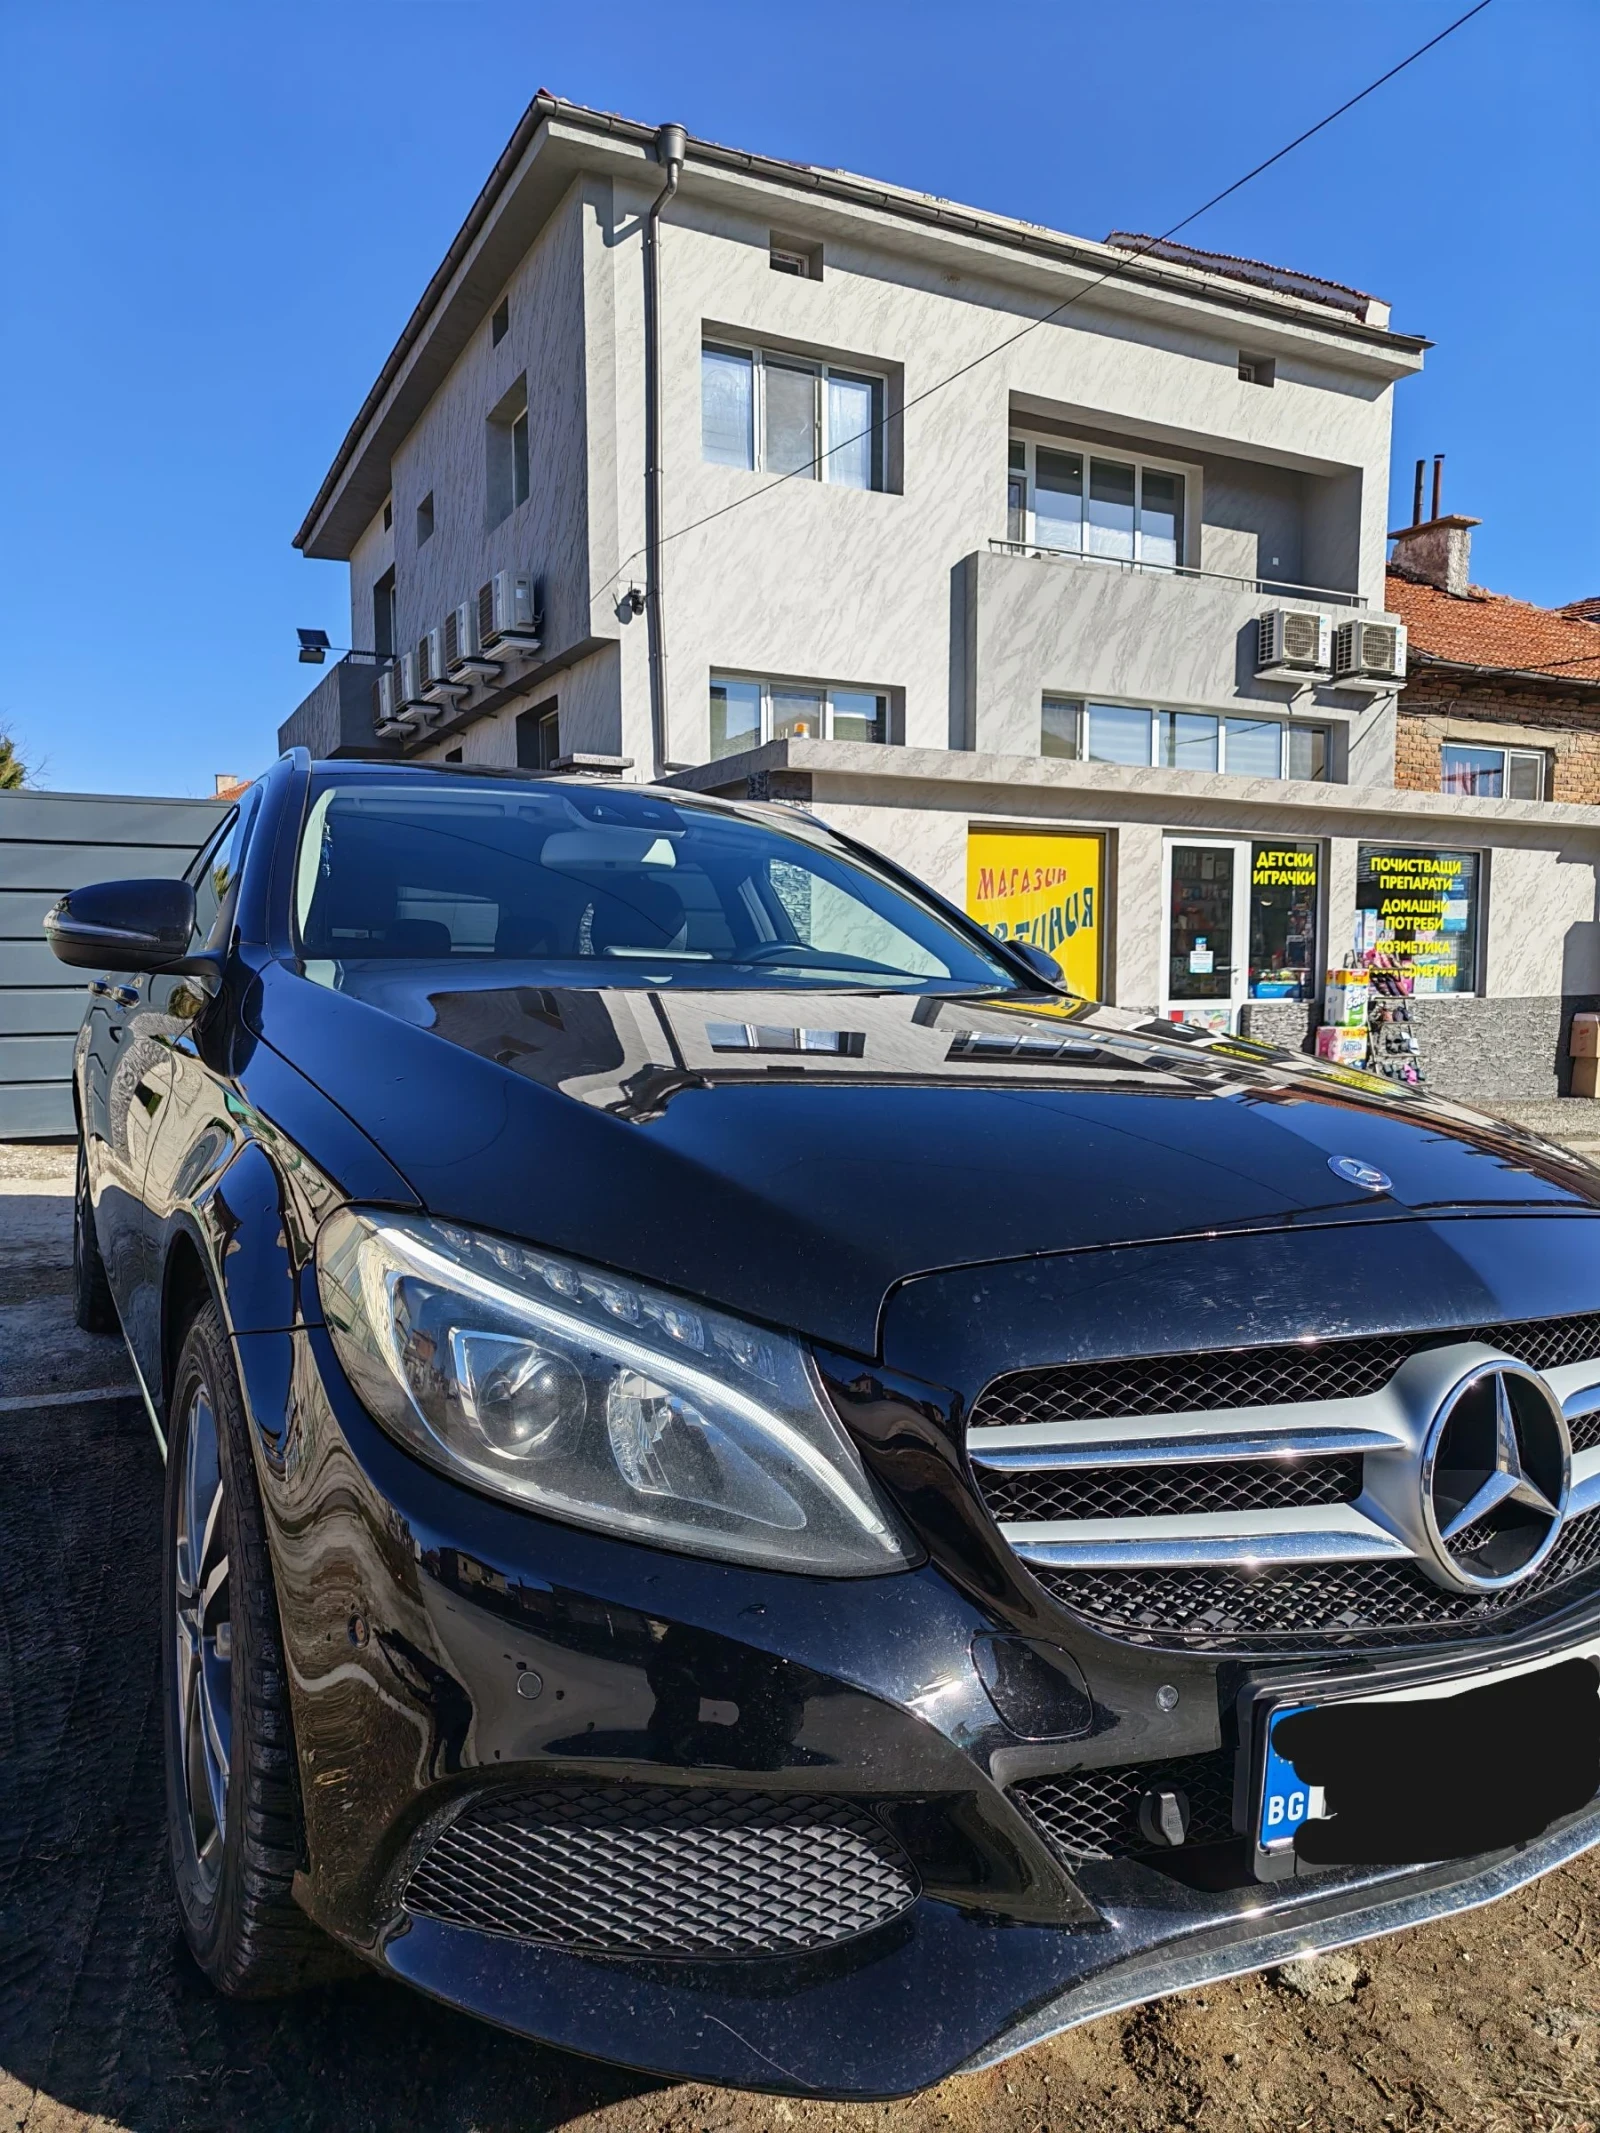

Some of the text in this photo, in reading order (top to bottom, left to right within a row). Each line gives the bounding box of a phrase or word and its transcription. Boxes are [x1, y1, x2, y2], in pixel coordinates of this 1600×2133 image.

[1256, 851, 1314, 868] ДЕТСКИ
[1370, 857, 1462, 876] ПОЧИСТВАЩИ
[976, 867, 1067, 900] МАГАЗИН
[1253, 870, 1316, 885] ИГРАЧКИ
[1379, 875, 1453, 891] ПРЕПАРАТИ
[1381, 898, 1450, 914] ДОМАШНИ
[1385, 916, 1444, 930] ПОТРЕБИ
[1375, 940, 1451, 954] КОЗМЕТИКА
[1267, 1792, 1305, 1826] BG
